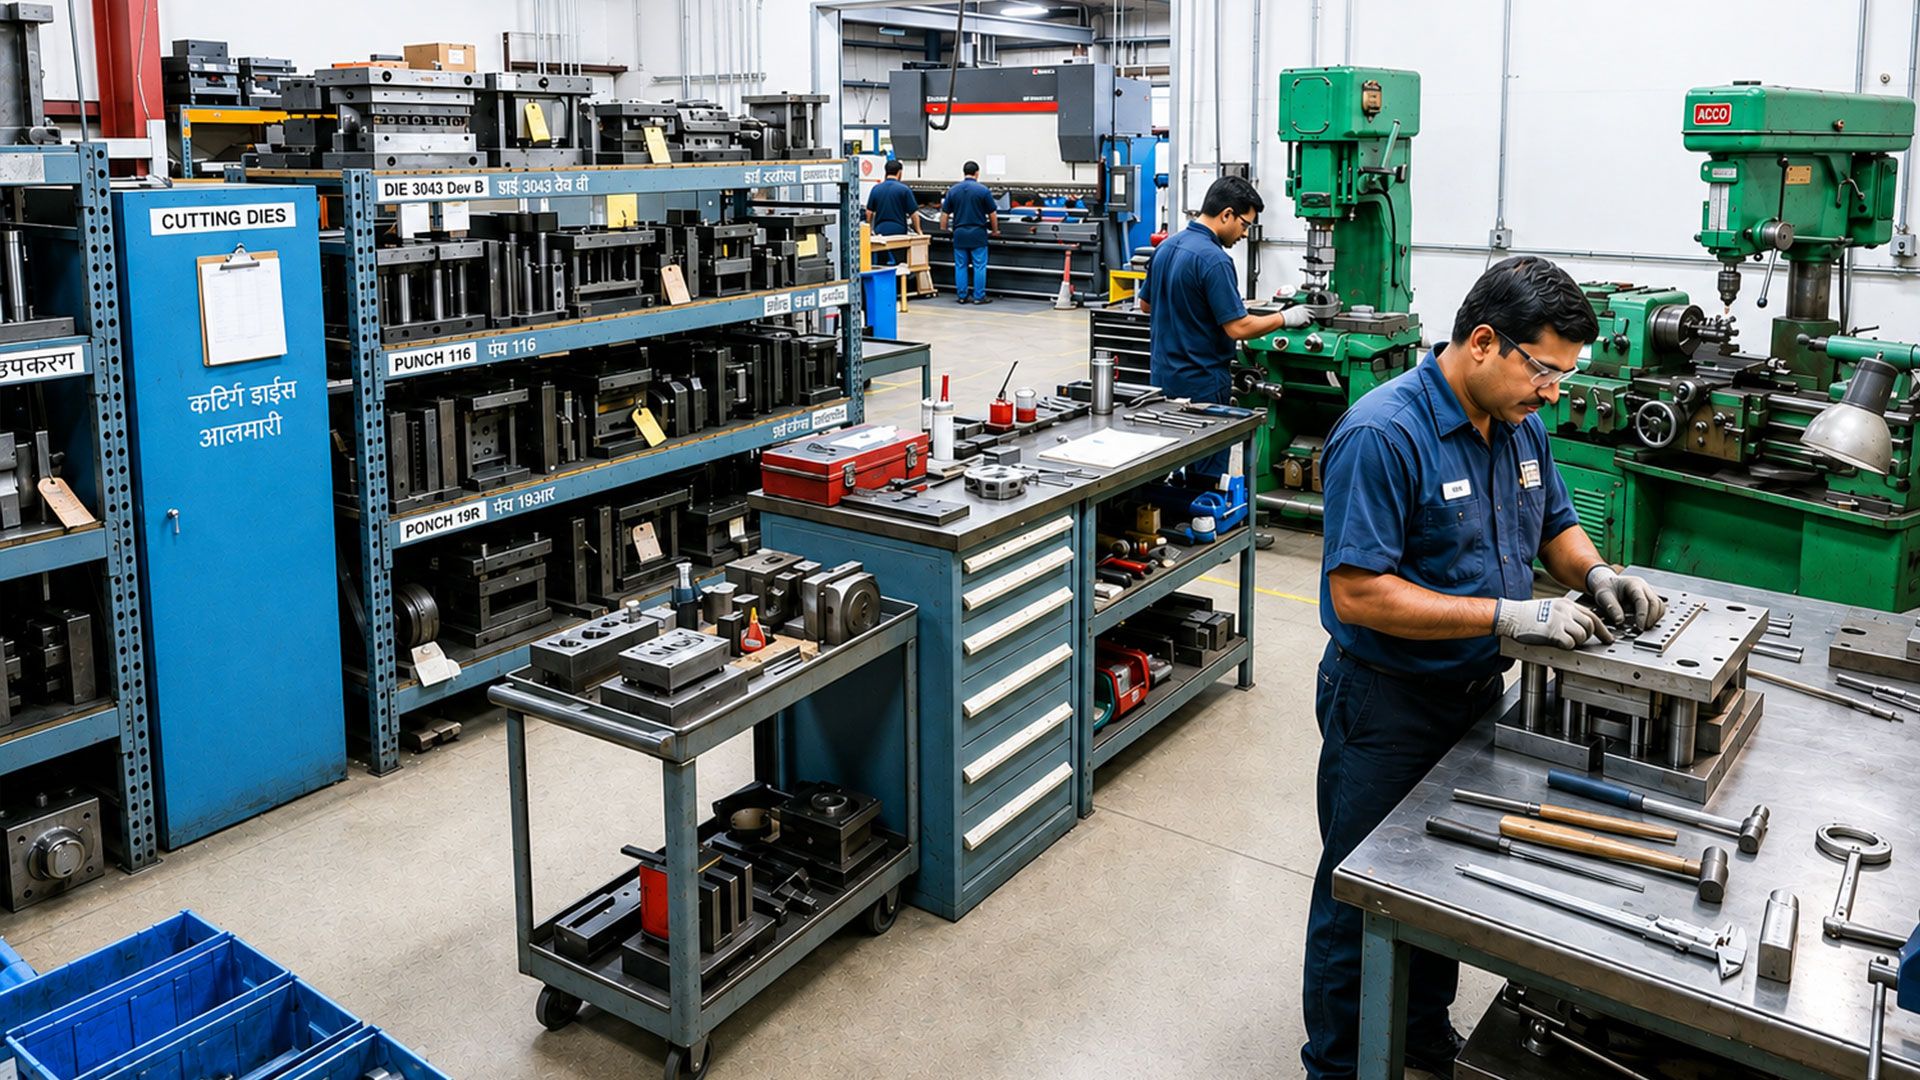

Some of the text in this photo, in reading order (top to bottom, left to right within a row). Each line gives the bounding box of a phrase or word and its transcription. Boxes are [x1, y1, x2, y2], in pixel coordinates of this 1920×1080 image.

[1697, 108, 1728, 120] ACCO
[384, 180, 485, 197] DIE 3043 Dev B
[522, 178, 552, 194] 3043
[162, 208, 287, 230] CUTTING DIES
[512, 337, 536, 355] 116
[394, 346, 471, 372] PUNCH 116
[199, 410, 284, 448] आलमारी
[405, 506, 480, 539] PONCH 19R
